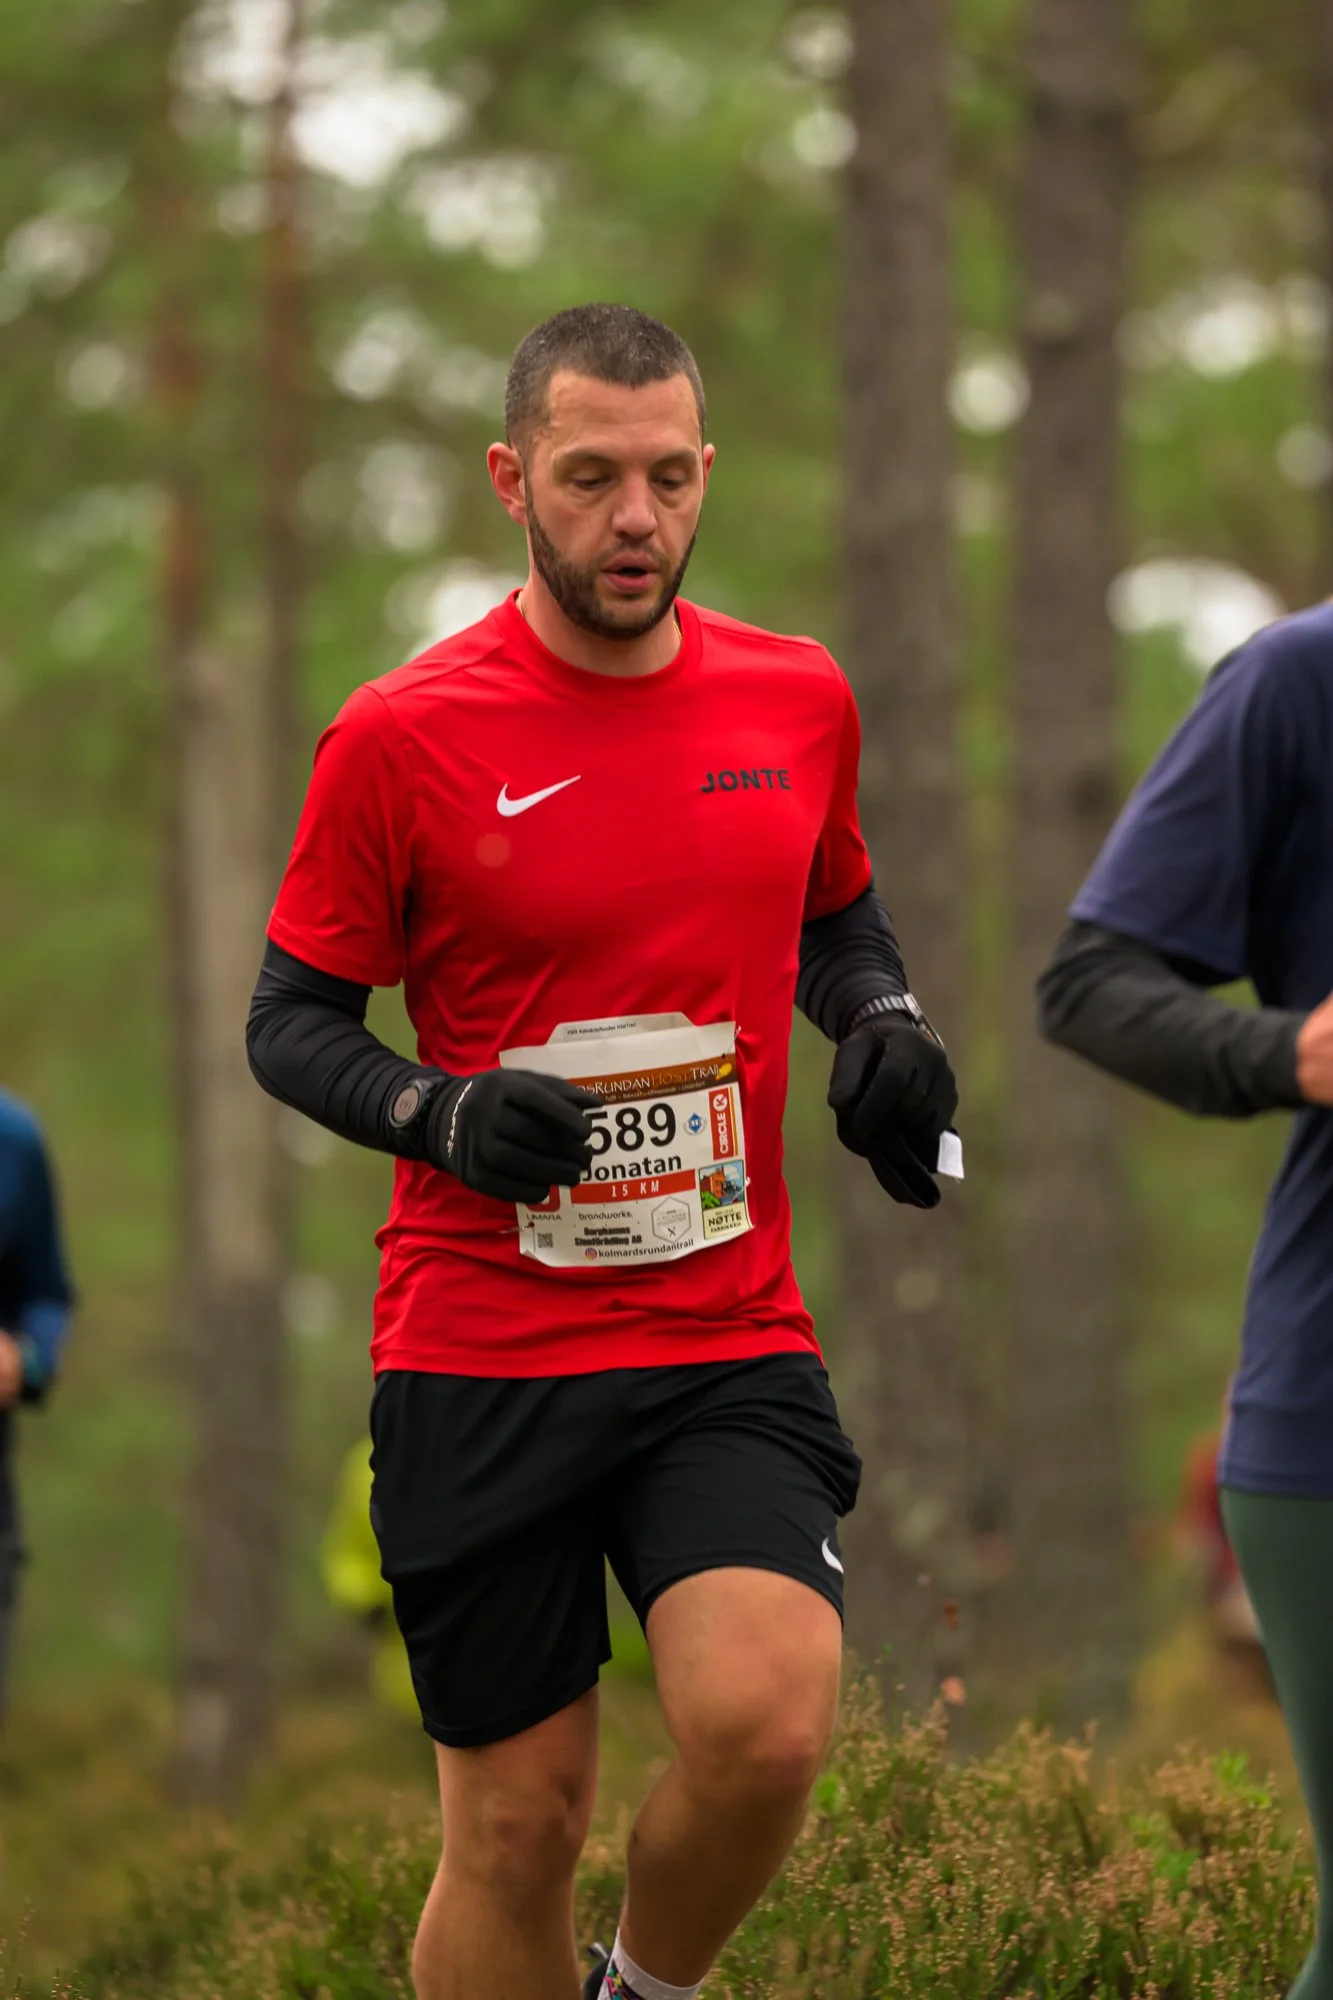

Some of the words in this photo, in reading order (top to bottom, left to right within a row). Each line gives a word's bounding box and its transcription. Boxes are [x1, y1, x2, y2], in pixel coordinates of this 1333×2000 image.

[701, 768, 791, 793] JONTE
[717, 1112, 728, 1154] CIRCLE
[583, 1155, 682, 1181] Jonatan
[640, 1180, 660, 1194] KM
[598, 1239, 694, 1258] kolmardsrundantrail
